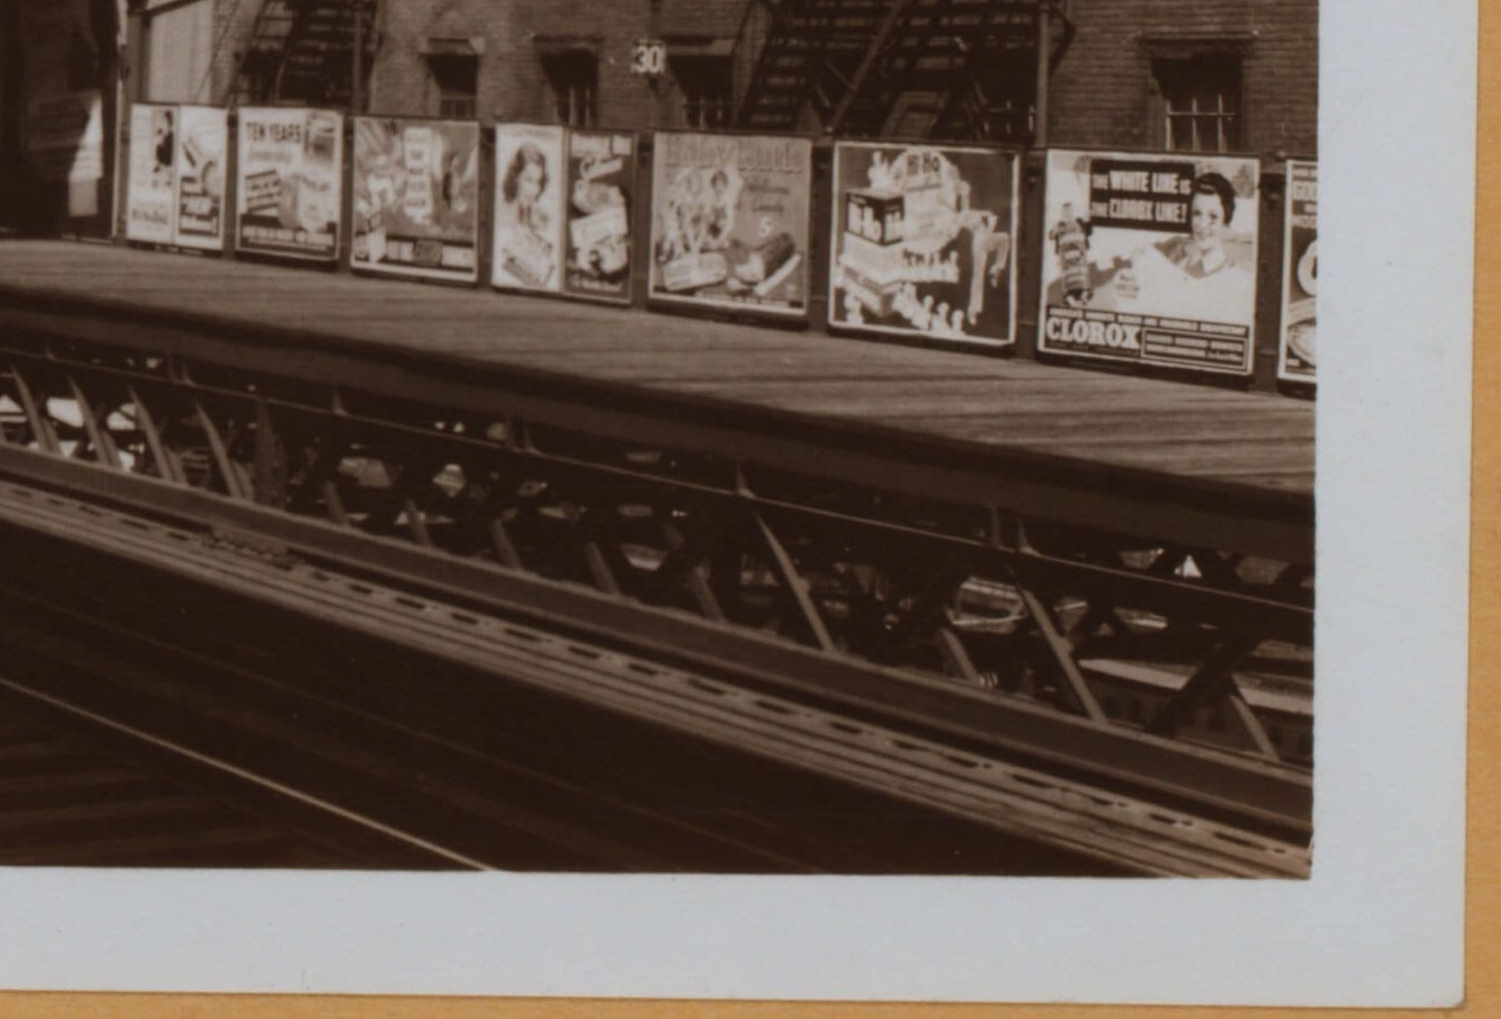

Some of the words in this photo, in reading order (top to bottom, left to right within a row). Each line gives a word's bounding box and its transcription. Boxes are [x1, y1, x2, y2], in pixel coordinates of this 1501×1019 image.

[635, 45, 661, 72] 30
[1109, 170, 1149, 191] WHITE
[1152, 172, 1180, 194] LINE
[1109, 198, 1154, 220] CLOROX
[1045, 316, 1141, 350] CLOROX
